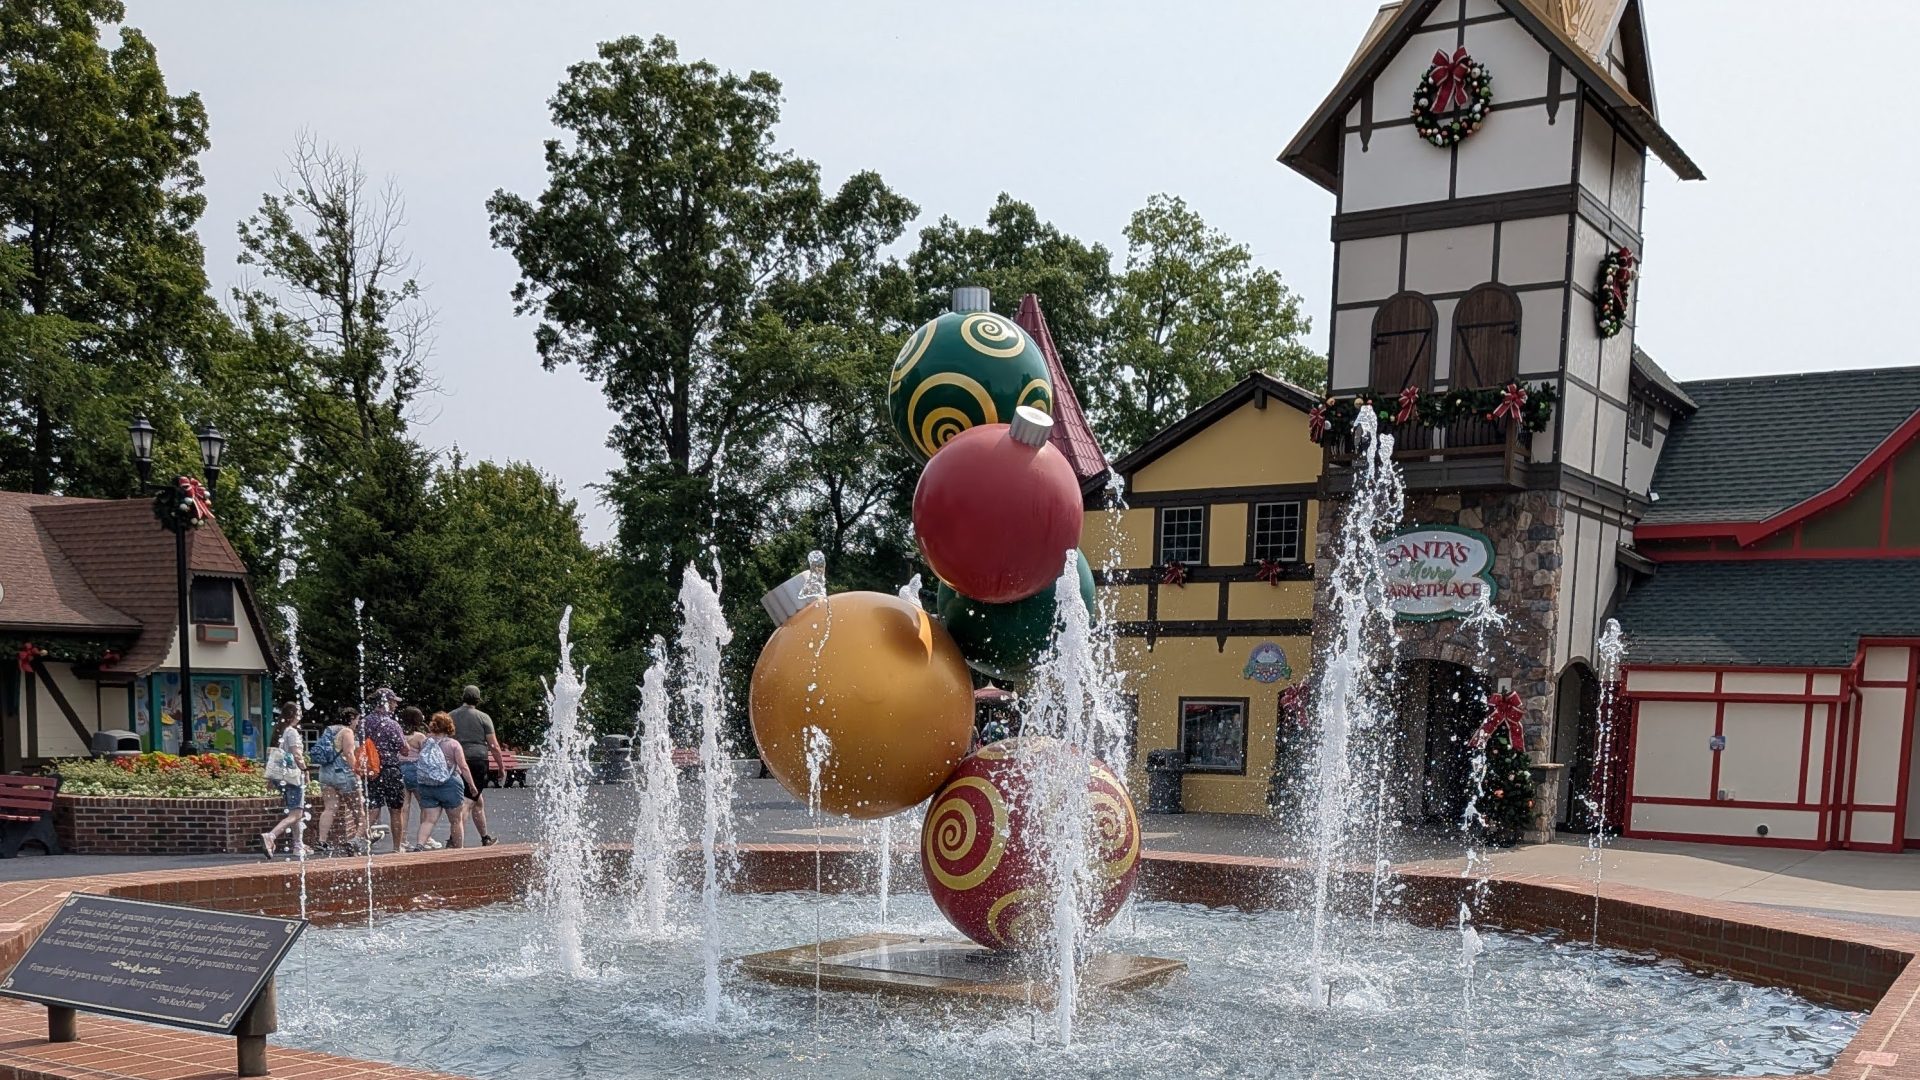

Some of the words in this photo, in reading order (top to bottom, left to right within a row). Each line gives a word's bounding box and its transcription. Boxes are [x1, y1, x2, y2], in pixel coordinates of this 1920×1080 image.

[1386, 541, 1470, 566] SANTA'S
[1399, 560, 1456, 582] Merry
[69, 916, 98, 926] Christmas
[97, 920, 111, 929] with
[192, 934, 210, 944] part
[215, 938, 234, 947] every
[119, 913, 155, 923] generations
[168, 917, 194, 929] family
[190, 920, 208, 929] have
[207, 922, 239, 933] celebrated
[67, 941, 86, 949] visited
[90, 945, 112, 954] park
[150, 951, 164, 959] this
[195, 960, 235, 969] generations
[68, 930, 83, 941] every
[83, 931, 114, 942] wonderful
[111, 936, 136, 947] memory
[134, 937, 152, 946] made
[165, 940, 181, 950] This
[178, 942, 210, 953] fountain
[213, 947, 244, 959] dedicated
[28, 963, 44, 971] From
[48, 964, 72, 979] family
[99, 973, 116, 982] wish
[128, 977, 147, 991] Merry
[146, 980, 175, 991] Christmas
[173, 984, 191, 996] today
[201, 990, 219, 1002] every
[169, 998, 185, 1006] Koch
[184, 1001, 207, 1011] Family
